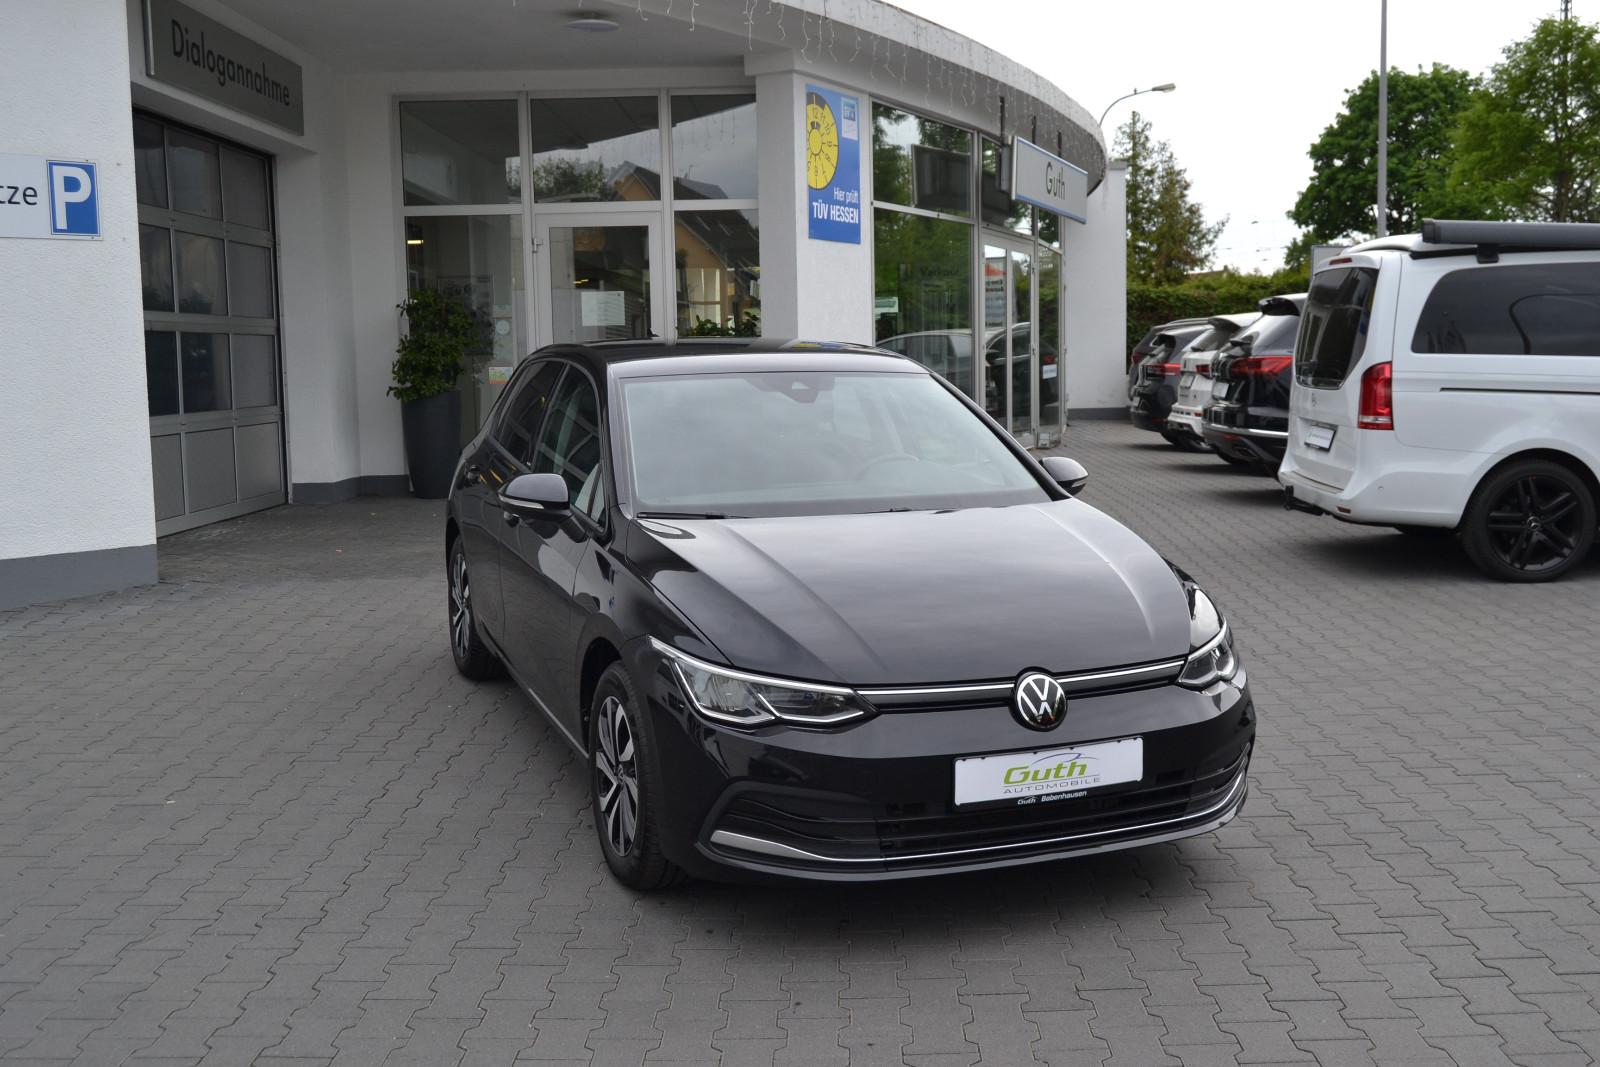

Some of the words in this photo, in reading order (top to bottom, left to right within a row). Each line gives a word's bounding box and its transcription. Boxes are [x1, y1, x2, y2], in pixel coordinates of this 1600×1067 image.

[171, 19, 290, 106] Dialogannahme
[1046, 161, 1066, 200] Guth
[52, 165, 92, 230] P
[833, 187, 845, 201] Hier
[812, 199, 829, 219] TÜV
[830, 204, 859, 224] HESSEN
[1003, 761, 1087, 785] Guth
[1003, 777, 1101, 795] AUTOMOBILE
[1041, 790, 1087, 802] Babenhausen
